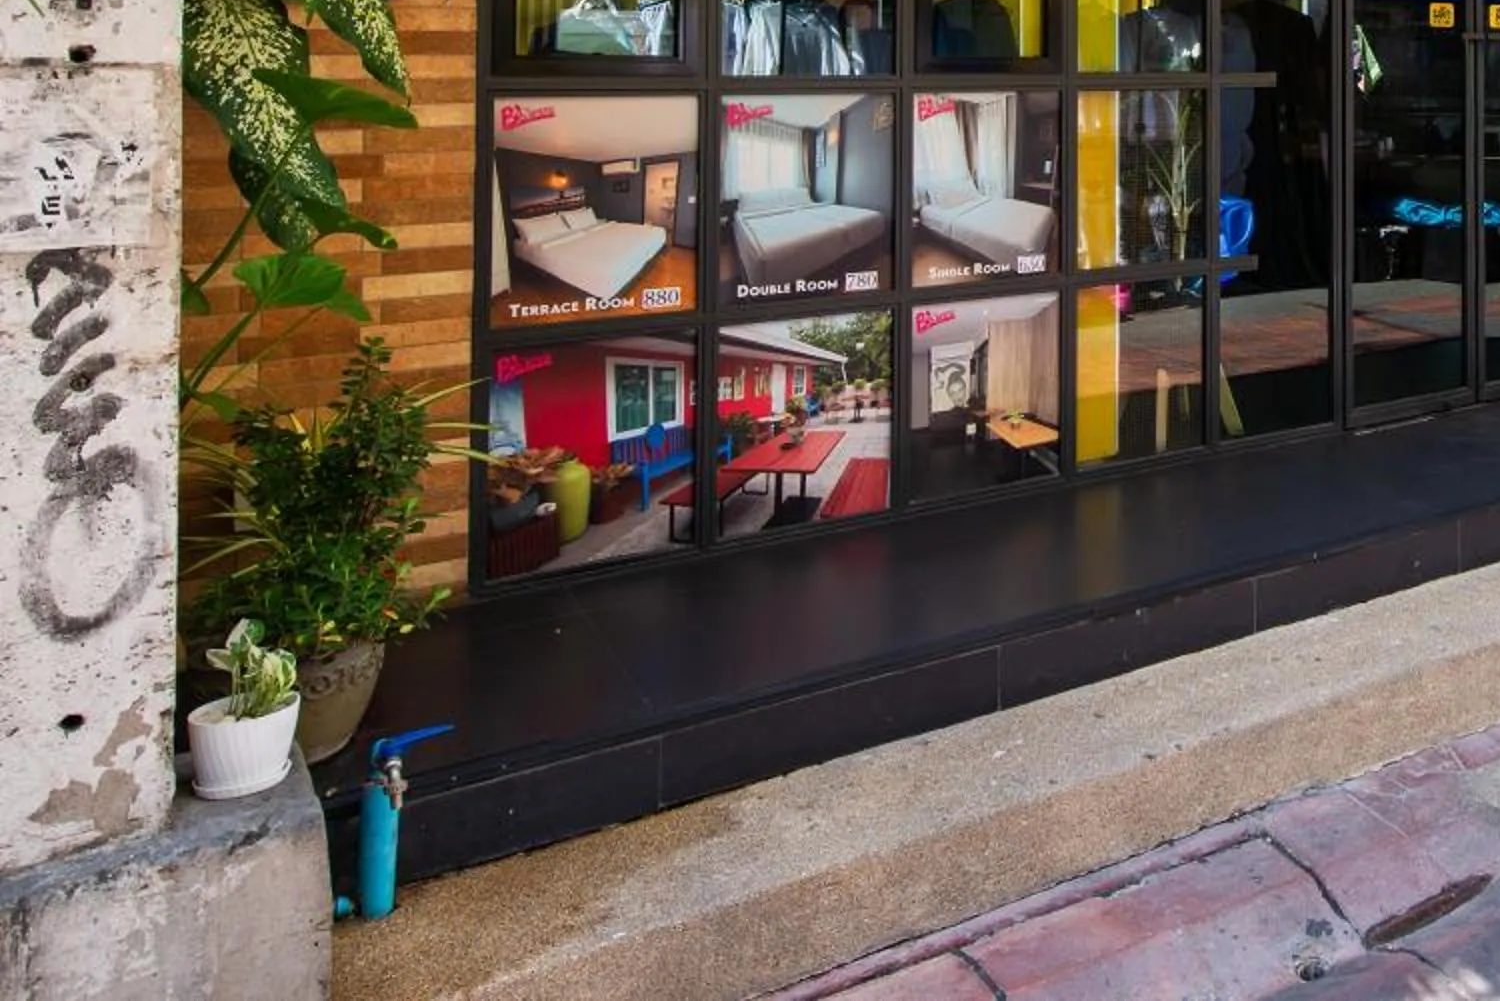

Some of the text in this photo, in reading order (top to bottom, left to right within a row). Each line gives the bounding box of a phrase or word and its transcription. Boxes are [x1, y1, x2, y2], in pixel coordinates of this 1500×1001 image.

[509, 289, 680, 318] TERRACE ROOM 880
